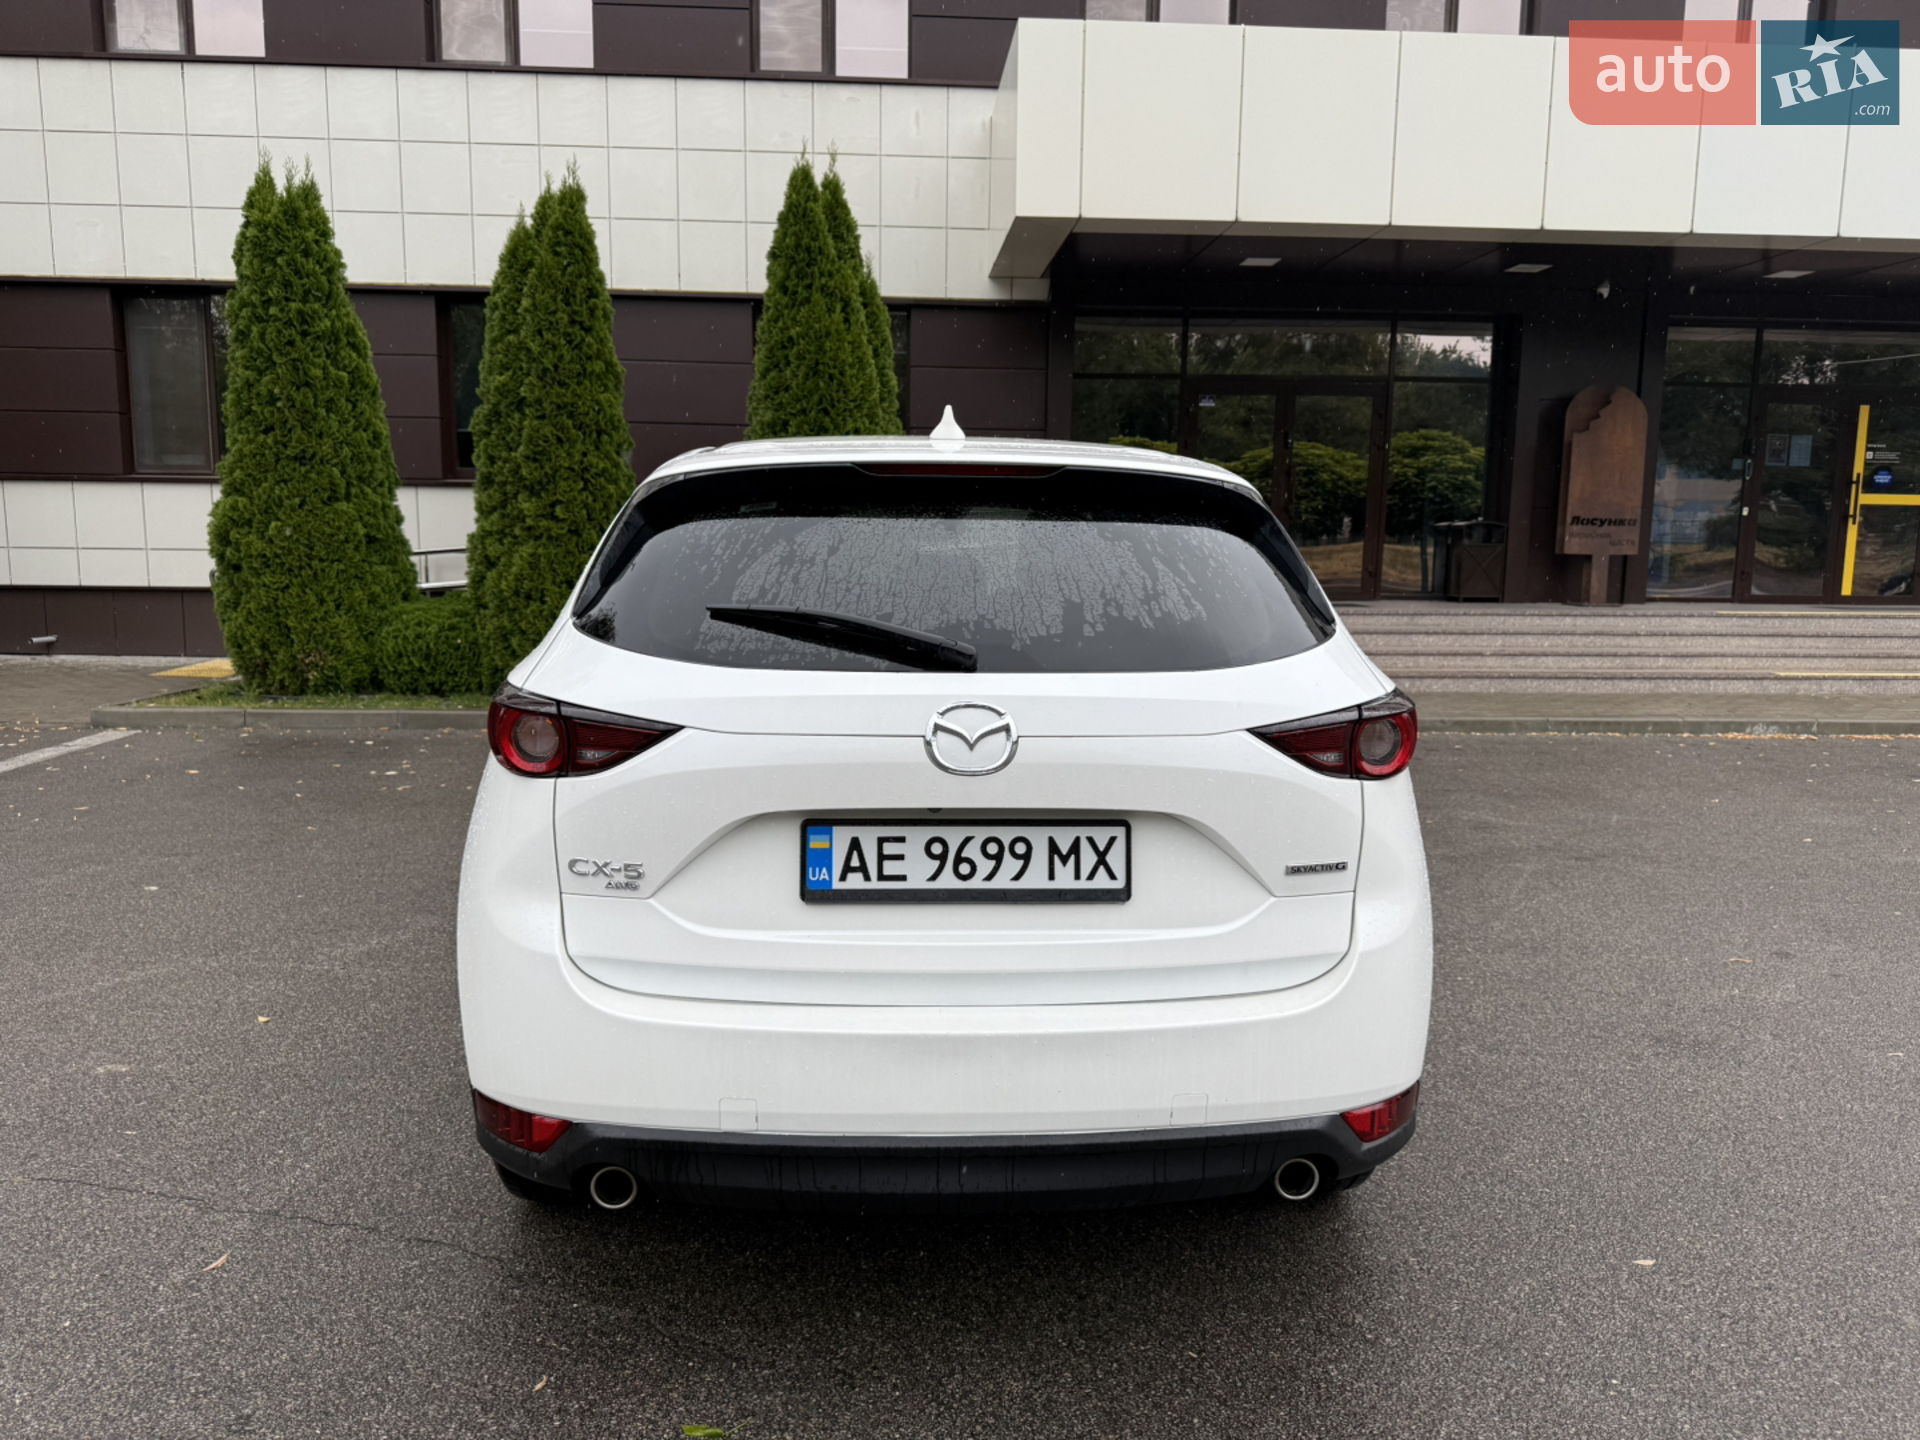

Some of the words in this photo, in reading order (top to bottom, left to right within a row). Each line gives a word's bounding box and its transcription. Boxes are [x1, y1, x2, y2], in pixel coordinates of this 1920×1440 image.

[1569, 516, 1638, 528] Ласунка
[567, 856, 645, 880] CX-5
[838, 836, 907, 882] AE
[924, 836, 1033, 882] 9699
[1047, 836, 1118, 881] MX
[808, 867, 830, 881] UA
